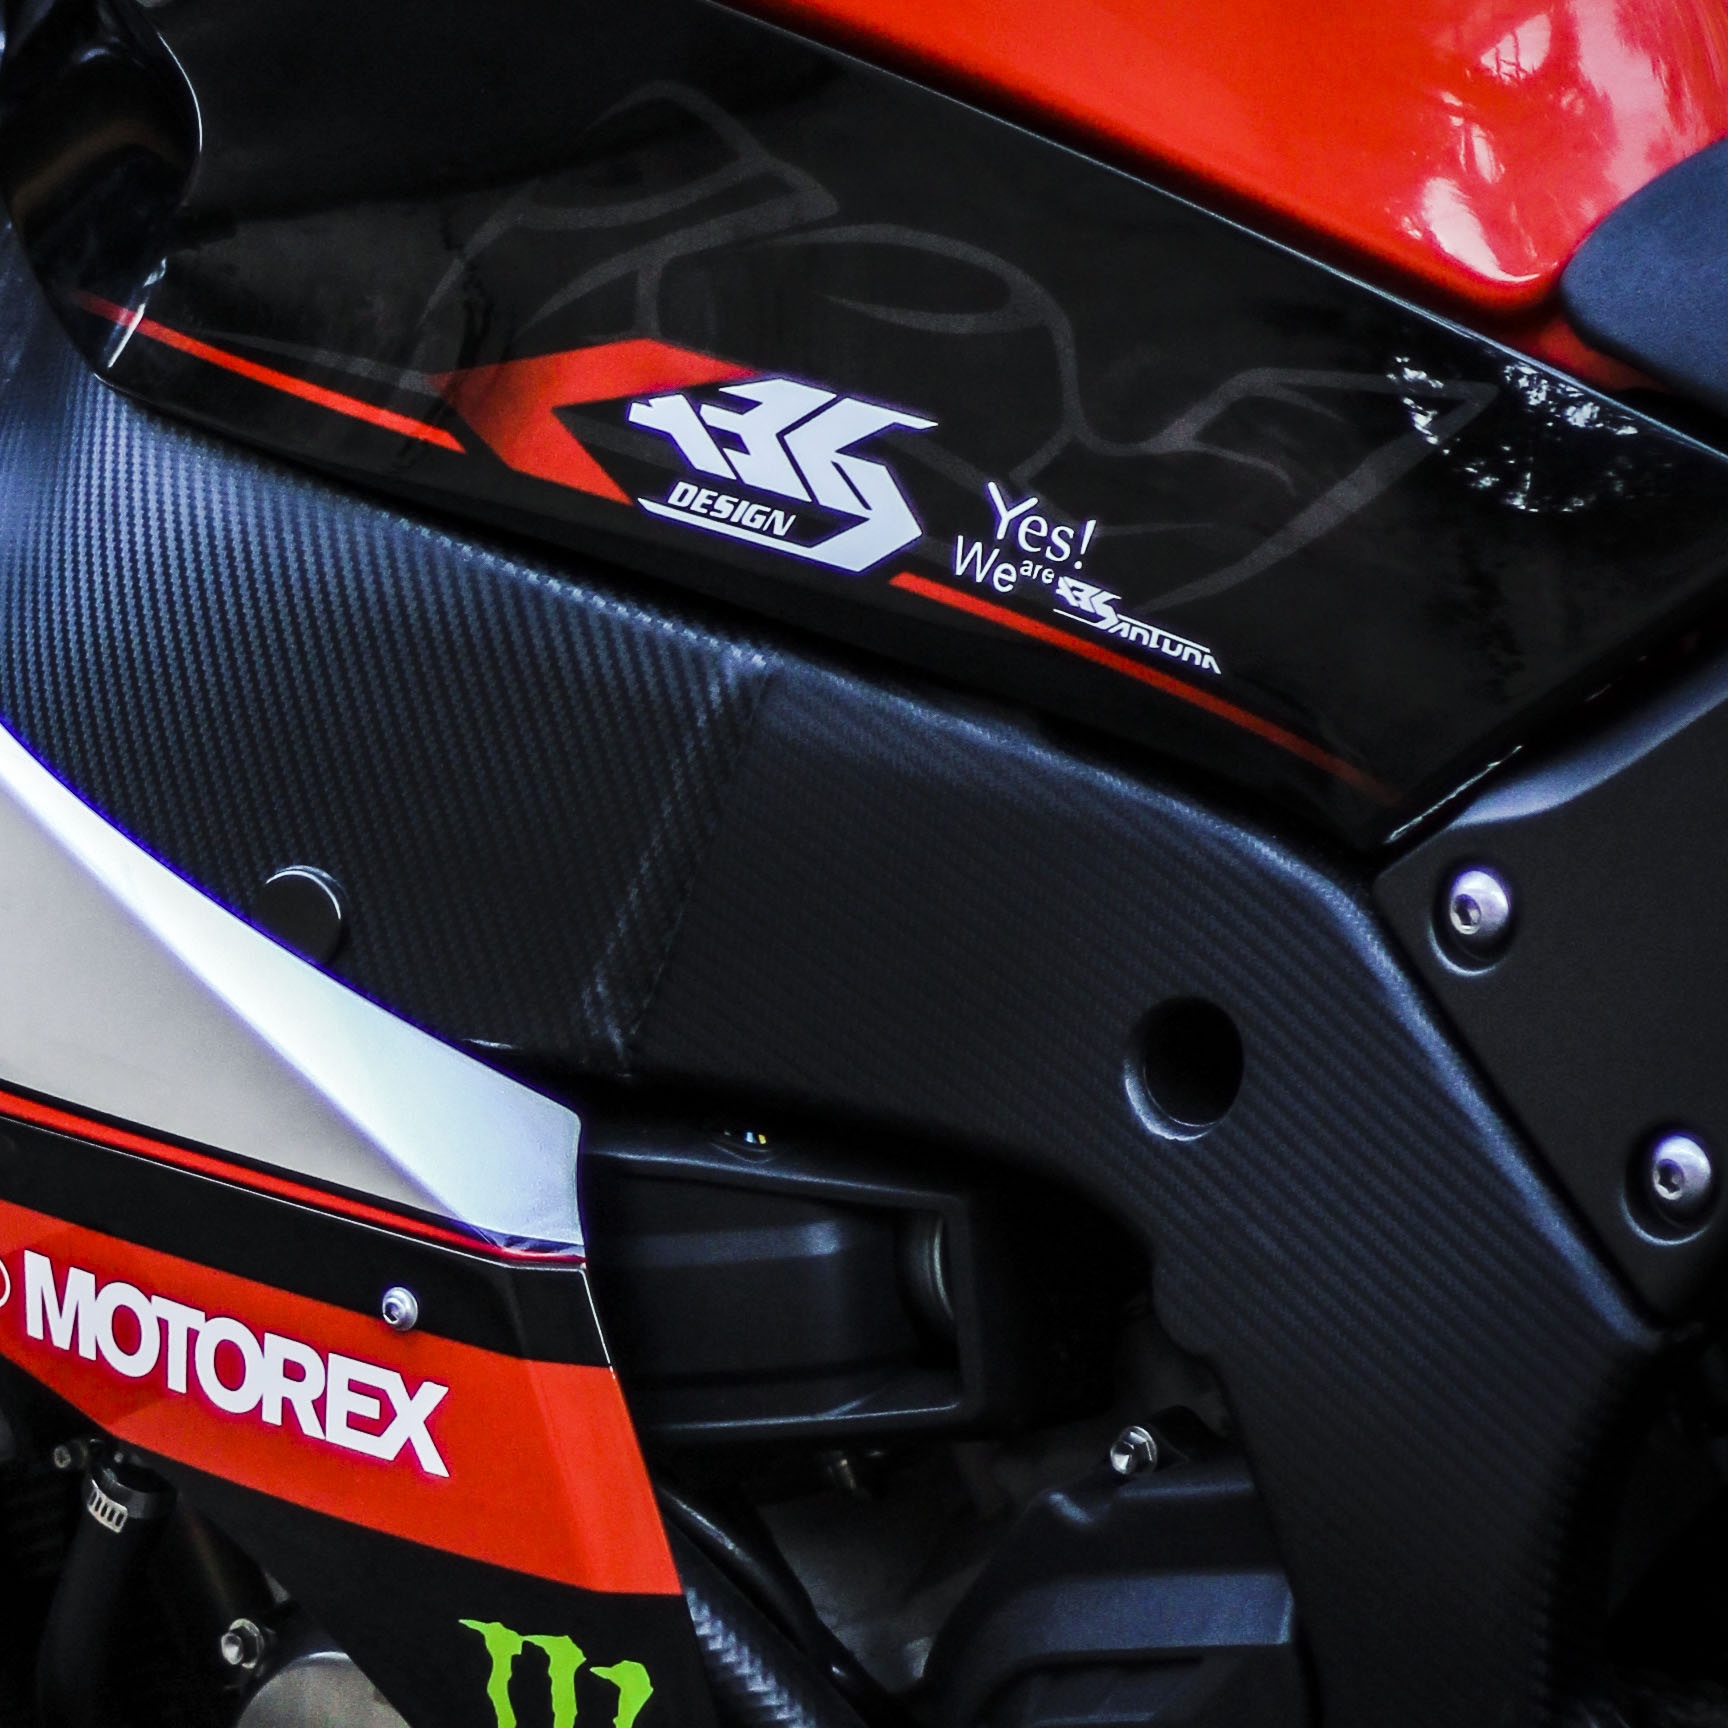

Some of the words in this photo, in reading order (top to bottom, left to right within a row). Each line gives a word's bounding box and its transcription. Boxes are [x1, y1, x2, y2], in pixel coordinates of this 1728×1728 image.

[668, 481, 796, 536] DESIGN
[987, 481, 1096, 570] Yes!
[955, 535, 1018, 593] We
[1019, 559, 1055, 584] are
[23, 1250, 449, 1477] MOTOREX
